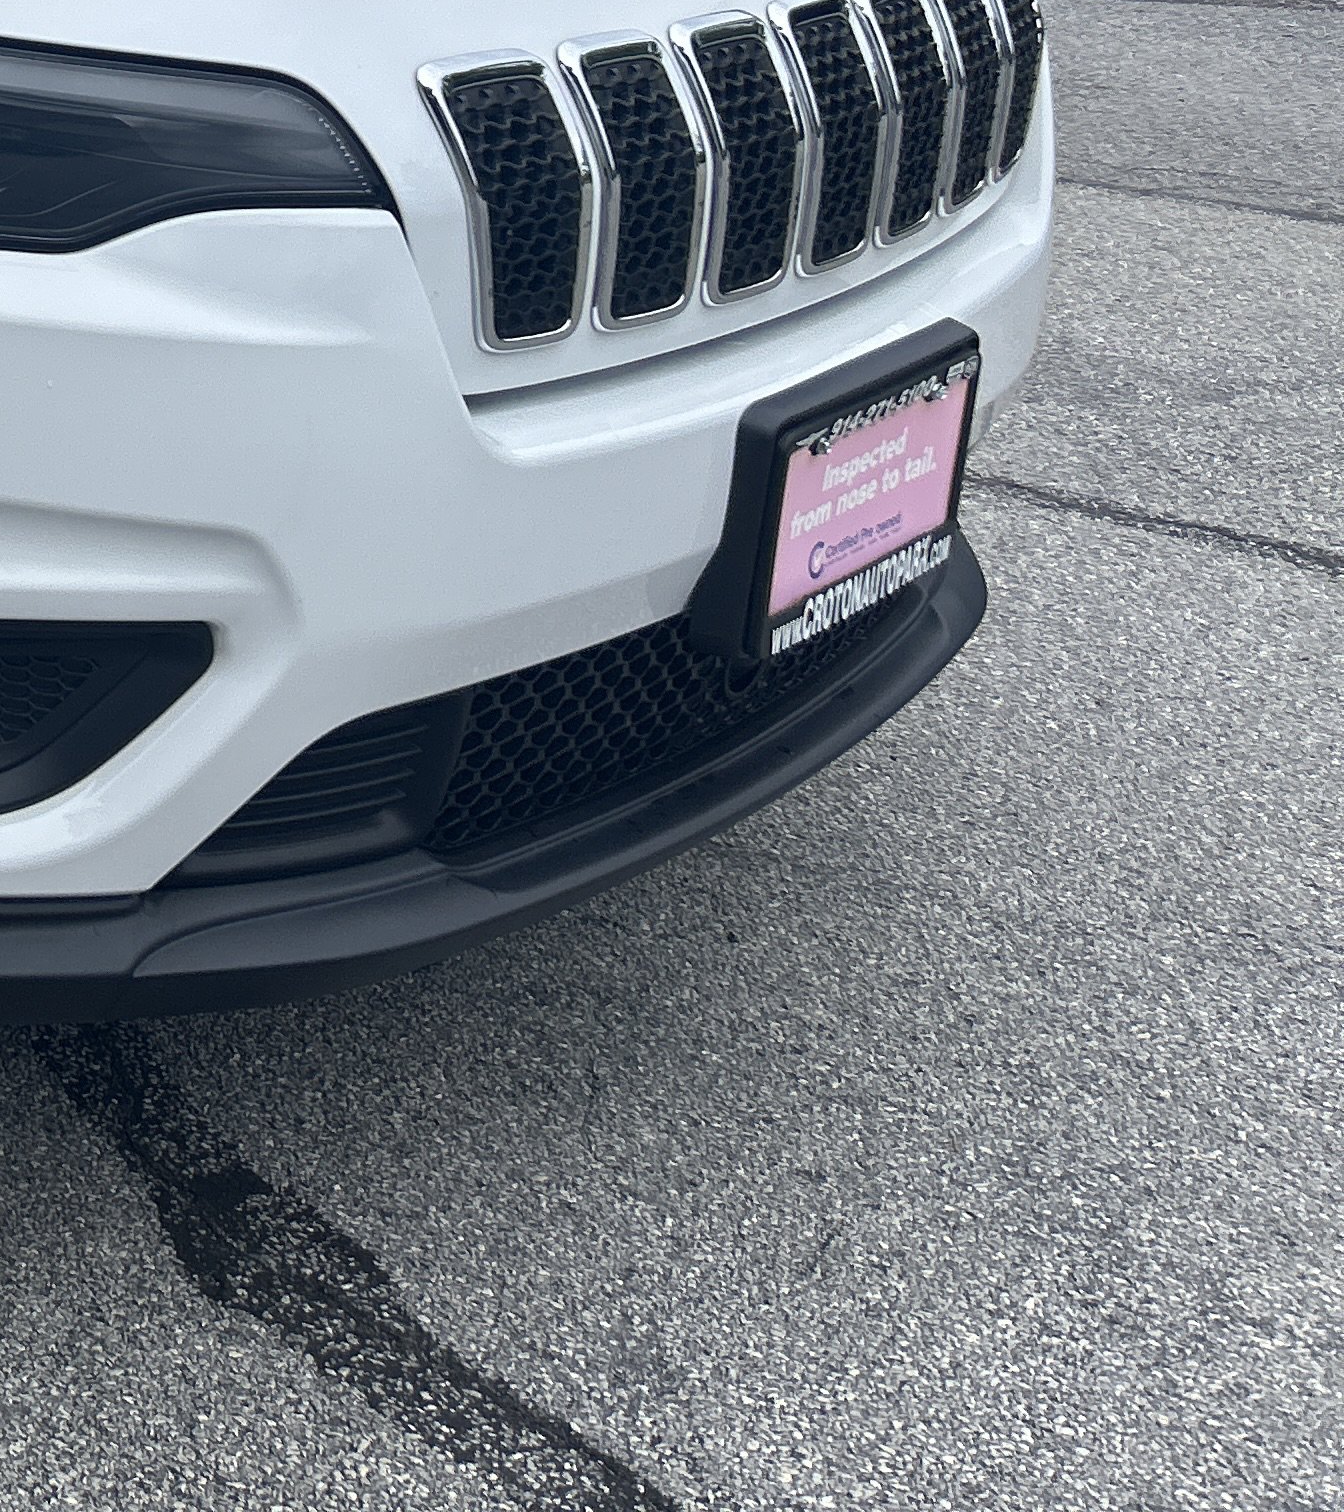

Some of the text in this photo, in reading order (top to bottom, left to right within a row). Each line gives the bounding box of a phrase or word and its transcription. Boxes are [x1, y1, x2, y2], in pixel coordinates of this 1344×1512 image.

[790, 501, 833, 539] from
[835, 479, 878, 516] nose
[882, 468, 900, 492] to
[904, 446, 936, 482] tail.
[822, 426, 908, 491] Inspected
